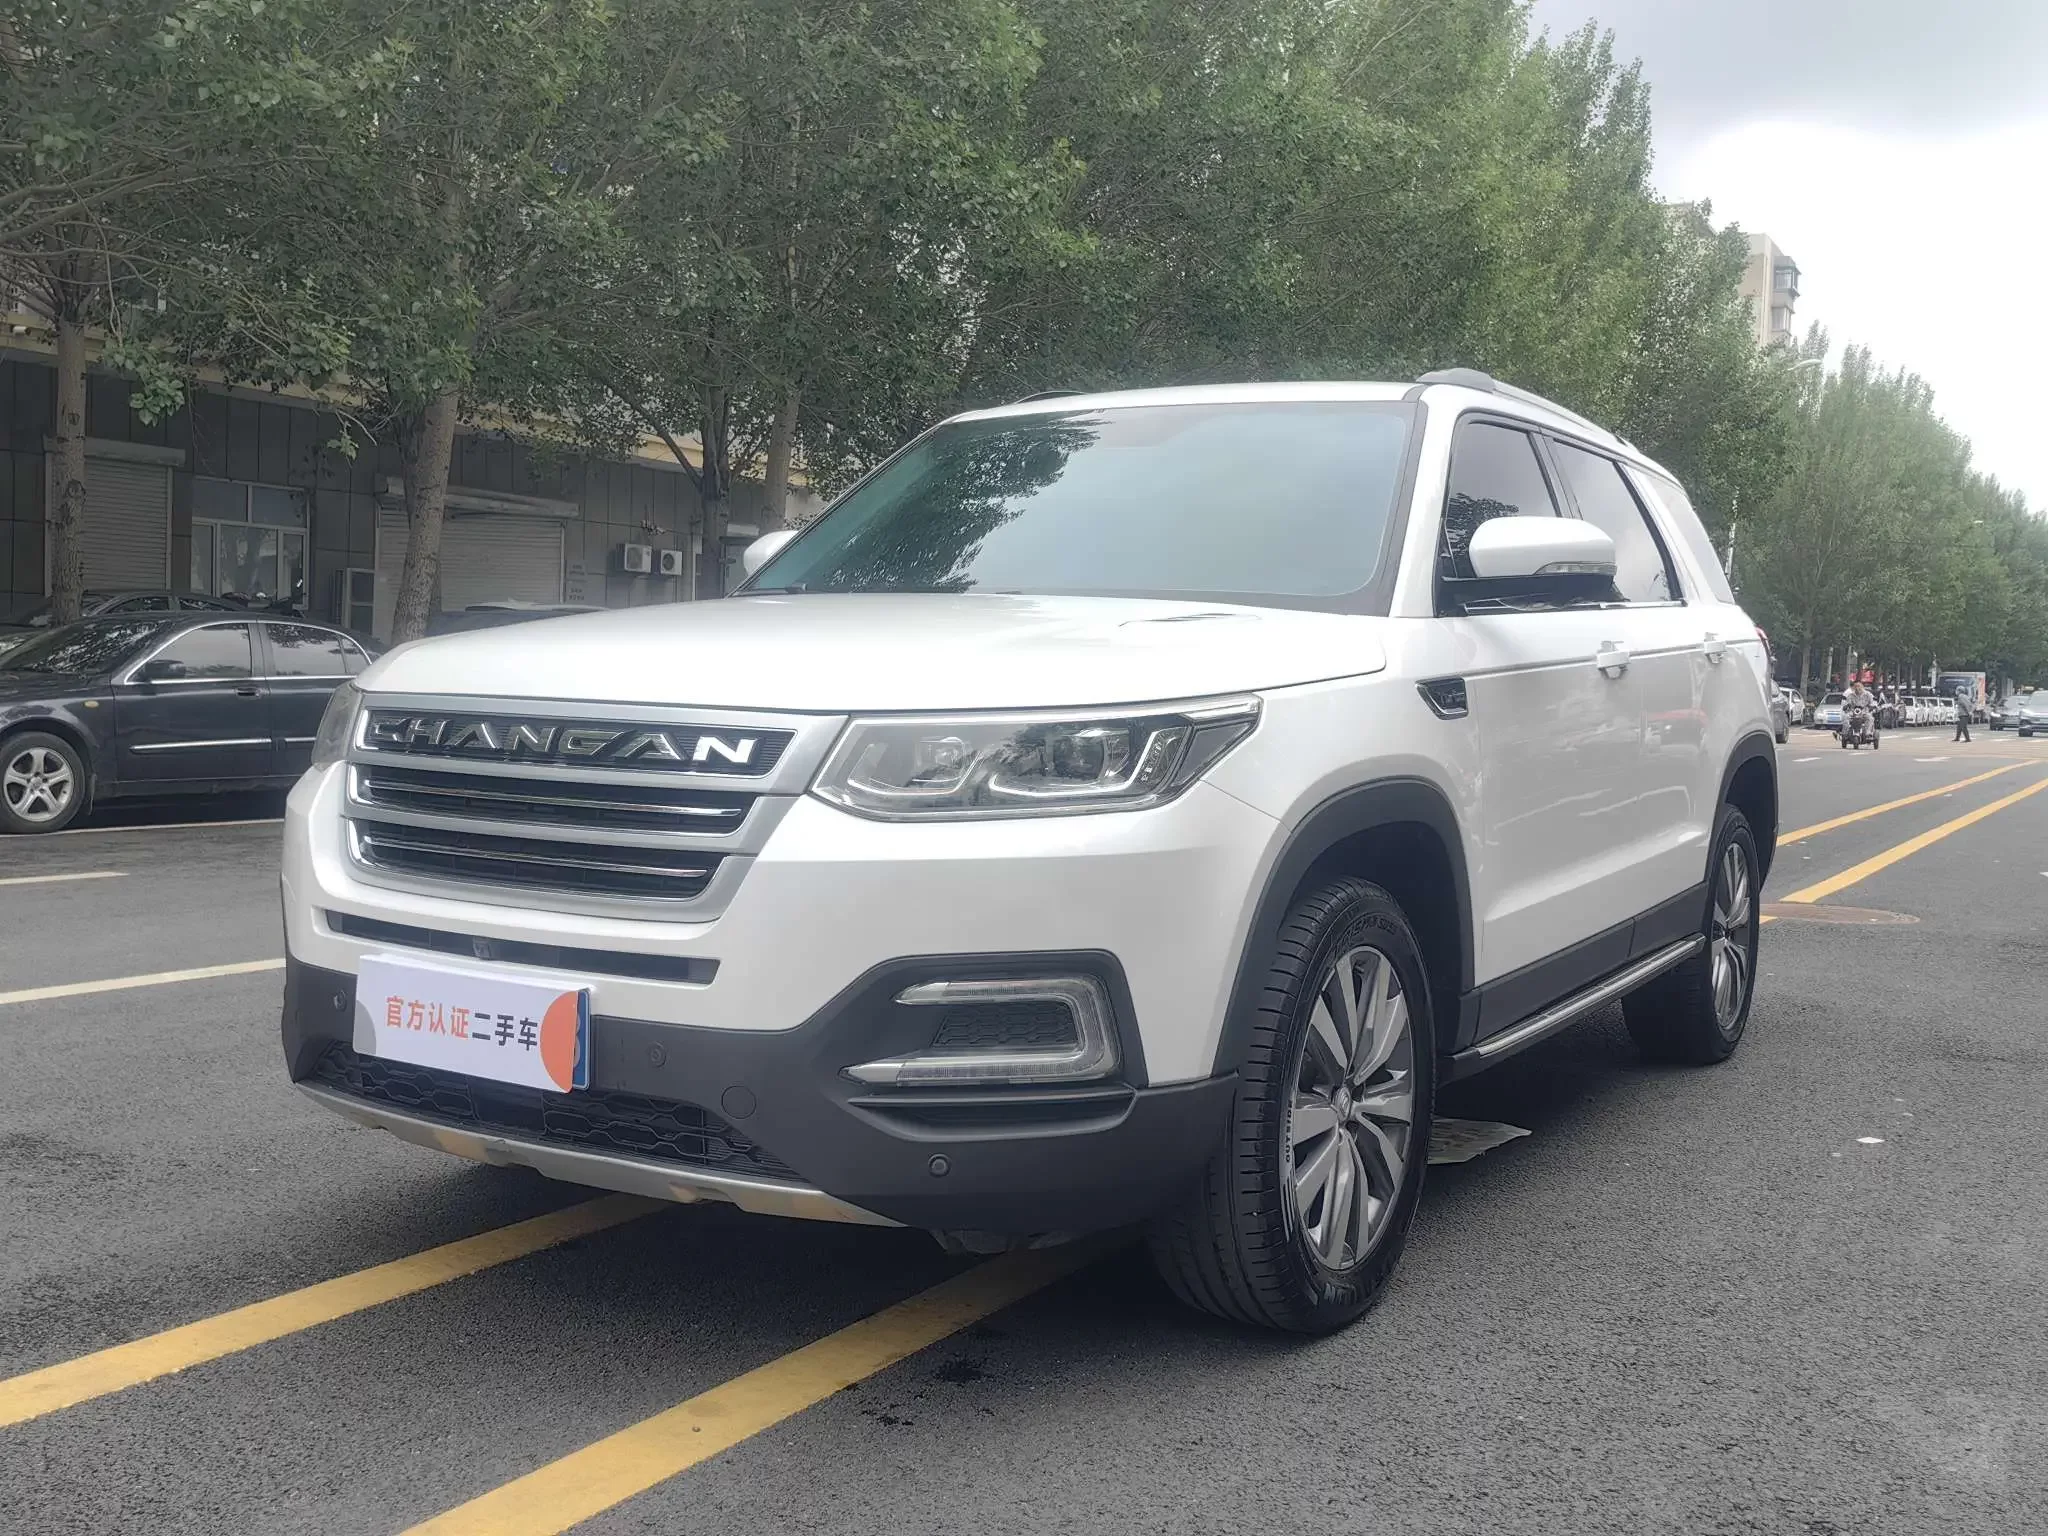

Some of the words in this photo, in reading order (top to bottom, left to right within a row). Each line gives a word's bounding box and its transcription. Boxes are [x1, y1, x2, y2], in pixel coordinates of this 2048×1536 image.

[373, 716, 758, 766] CHANGAN
[385, 995, 538, 1052] 官方认证二手车
